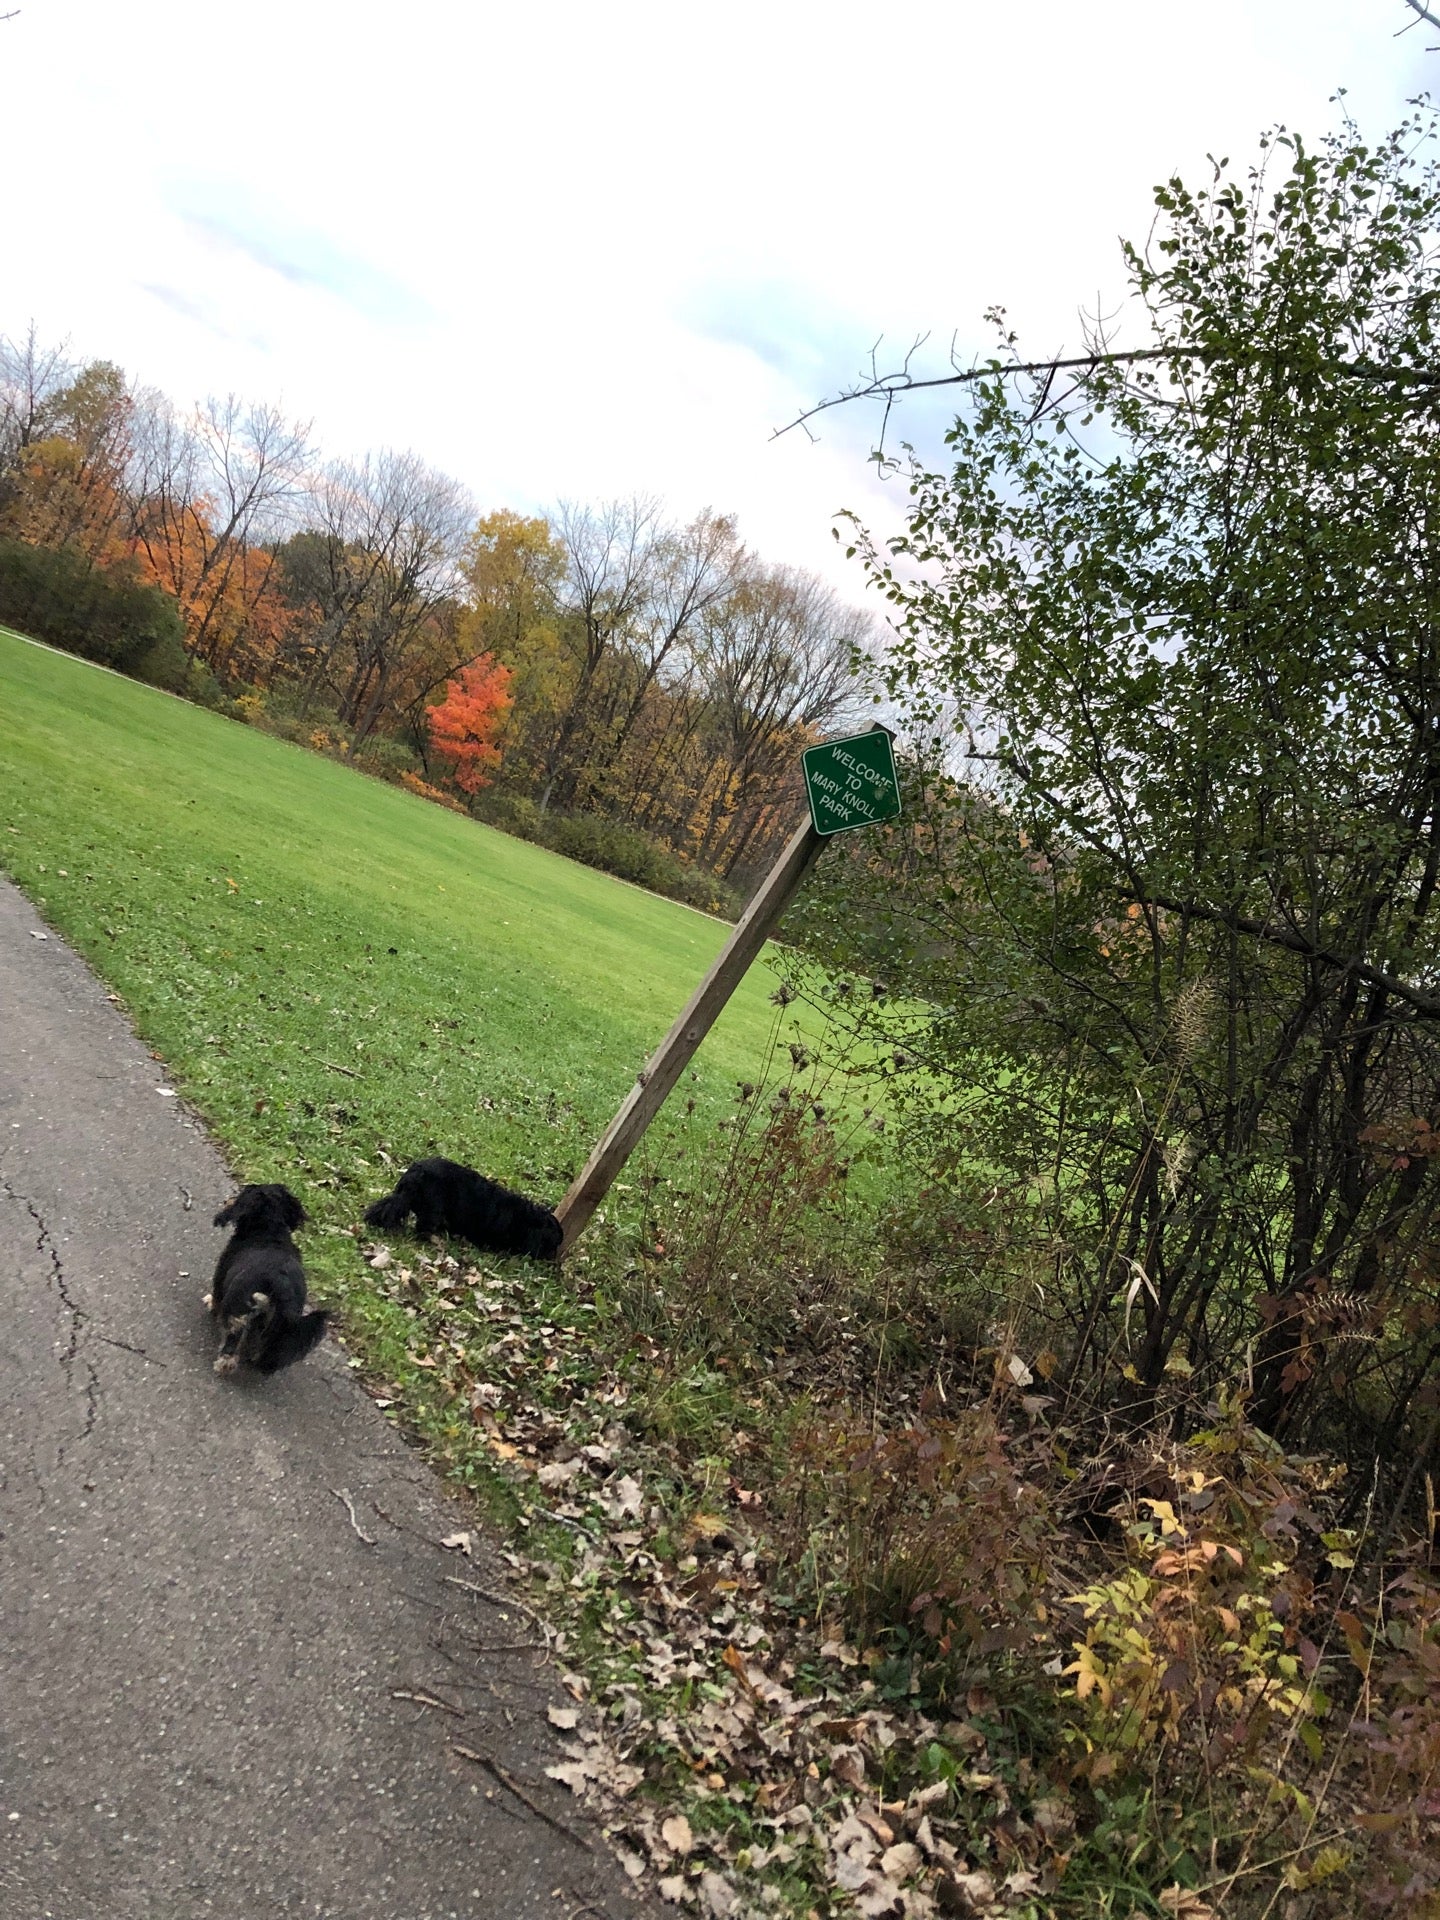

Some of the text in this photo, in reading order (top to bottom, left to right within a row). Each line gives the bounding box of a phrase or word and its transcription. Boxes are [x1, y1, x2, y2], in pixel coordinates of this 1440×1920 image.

[831, 746, 893, 792] WELCOME
[845, 773, 862, 790] TO
[811, 771, 875, 819] MARY KNOLL
[819, 795, 852, 821] PARK
